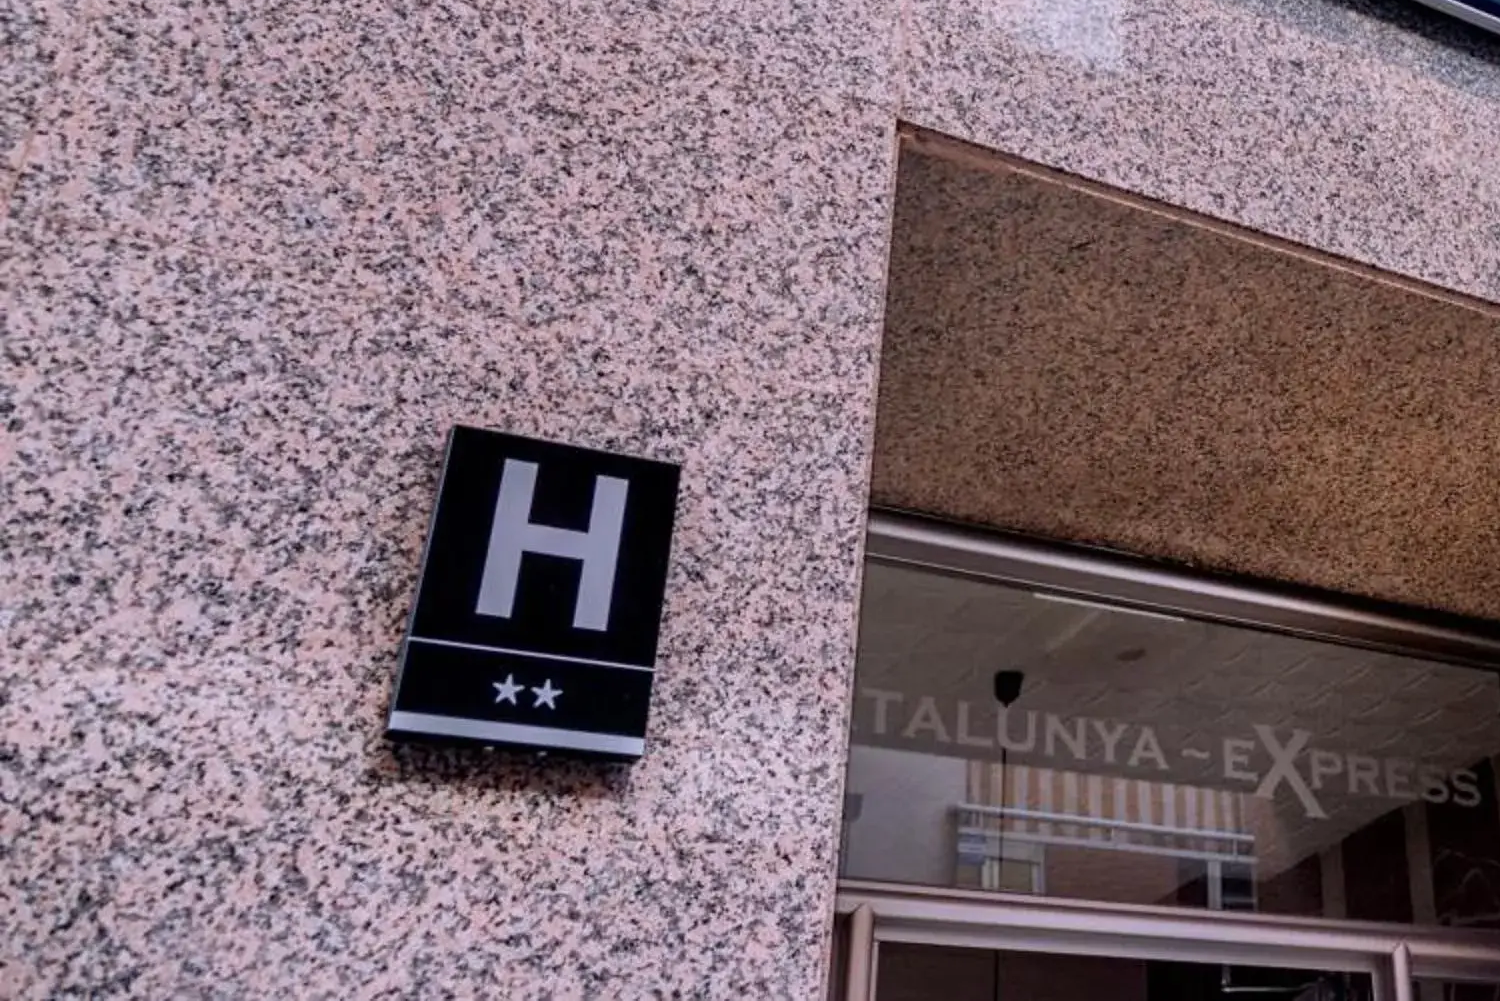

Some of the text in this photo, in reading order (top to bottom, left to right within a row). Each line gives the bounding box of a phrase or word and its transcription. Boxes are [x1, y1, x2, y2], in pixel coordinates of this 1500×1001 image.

[475, 458, 629, 632] H
[851, 687, 1170, 771] TALUNYA
[1223, 724, 1482, 819] EXPRESS
